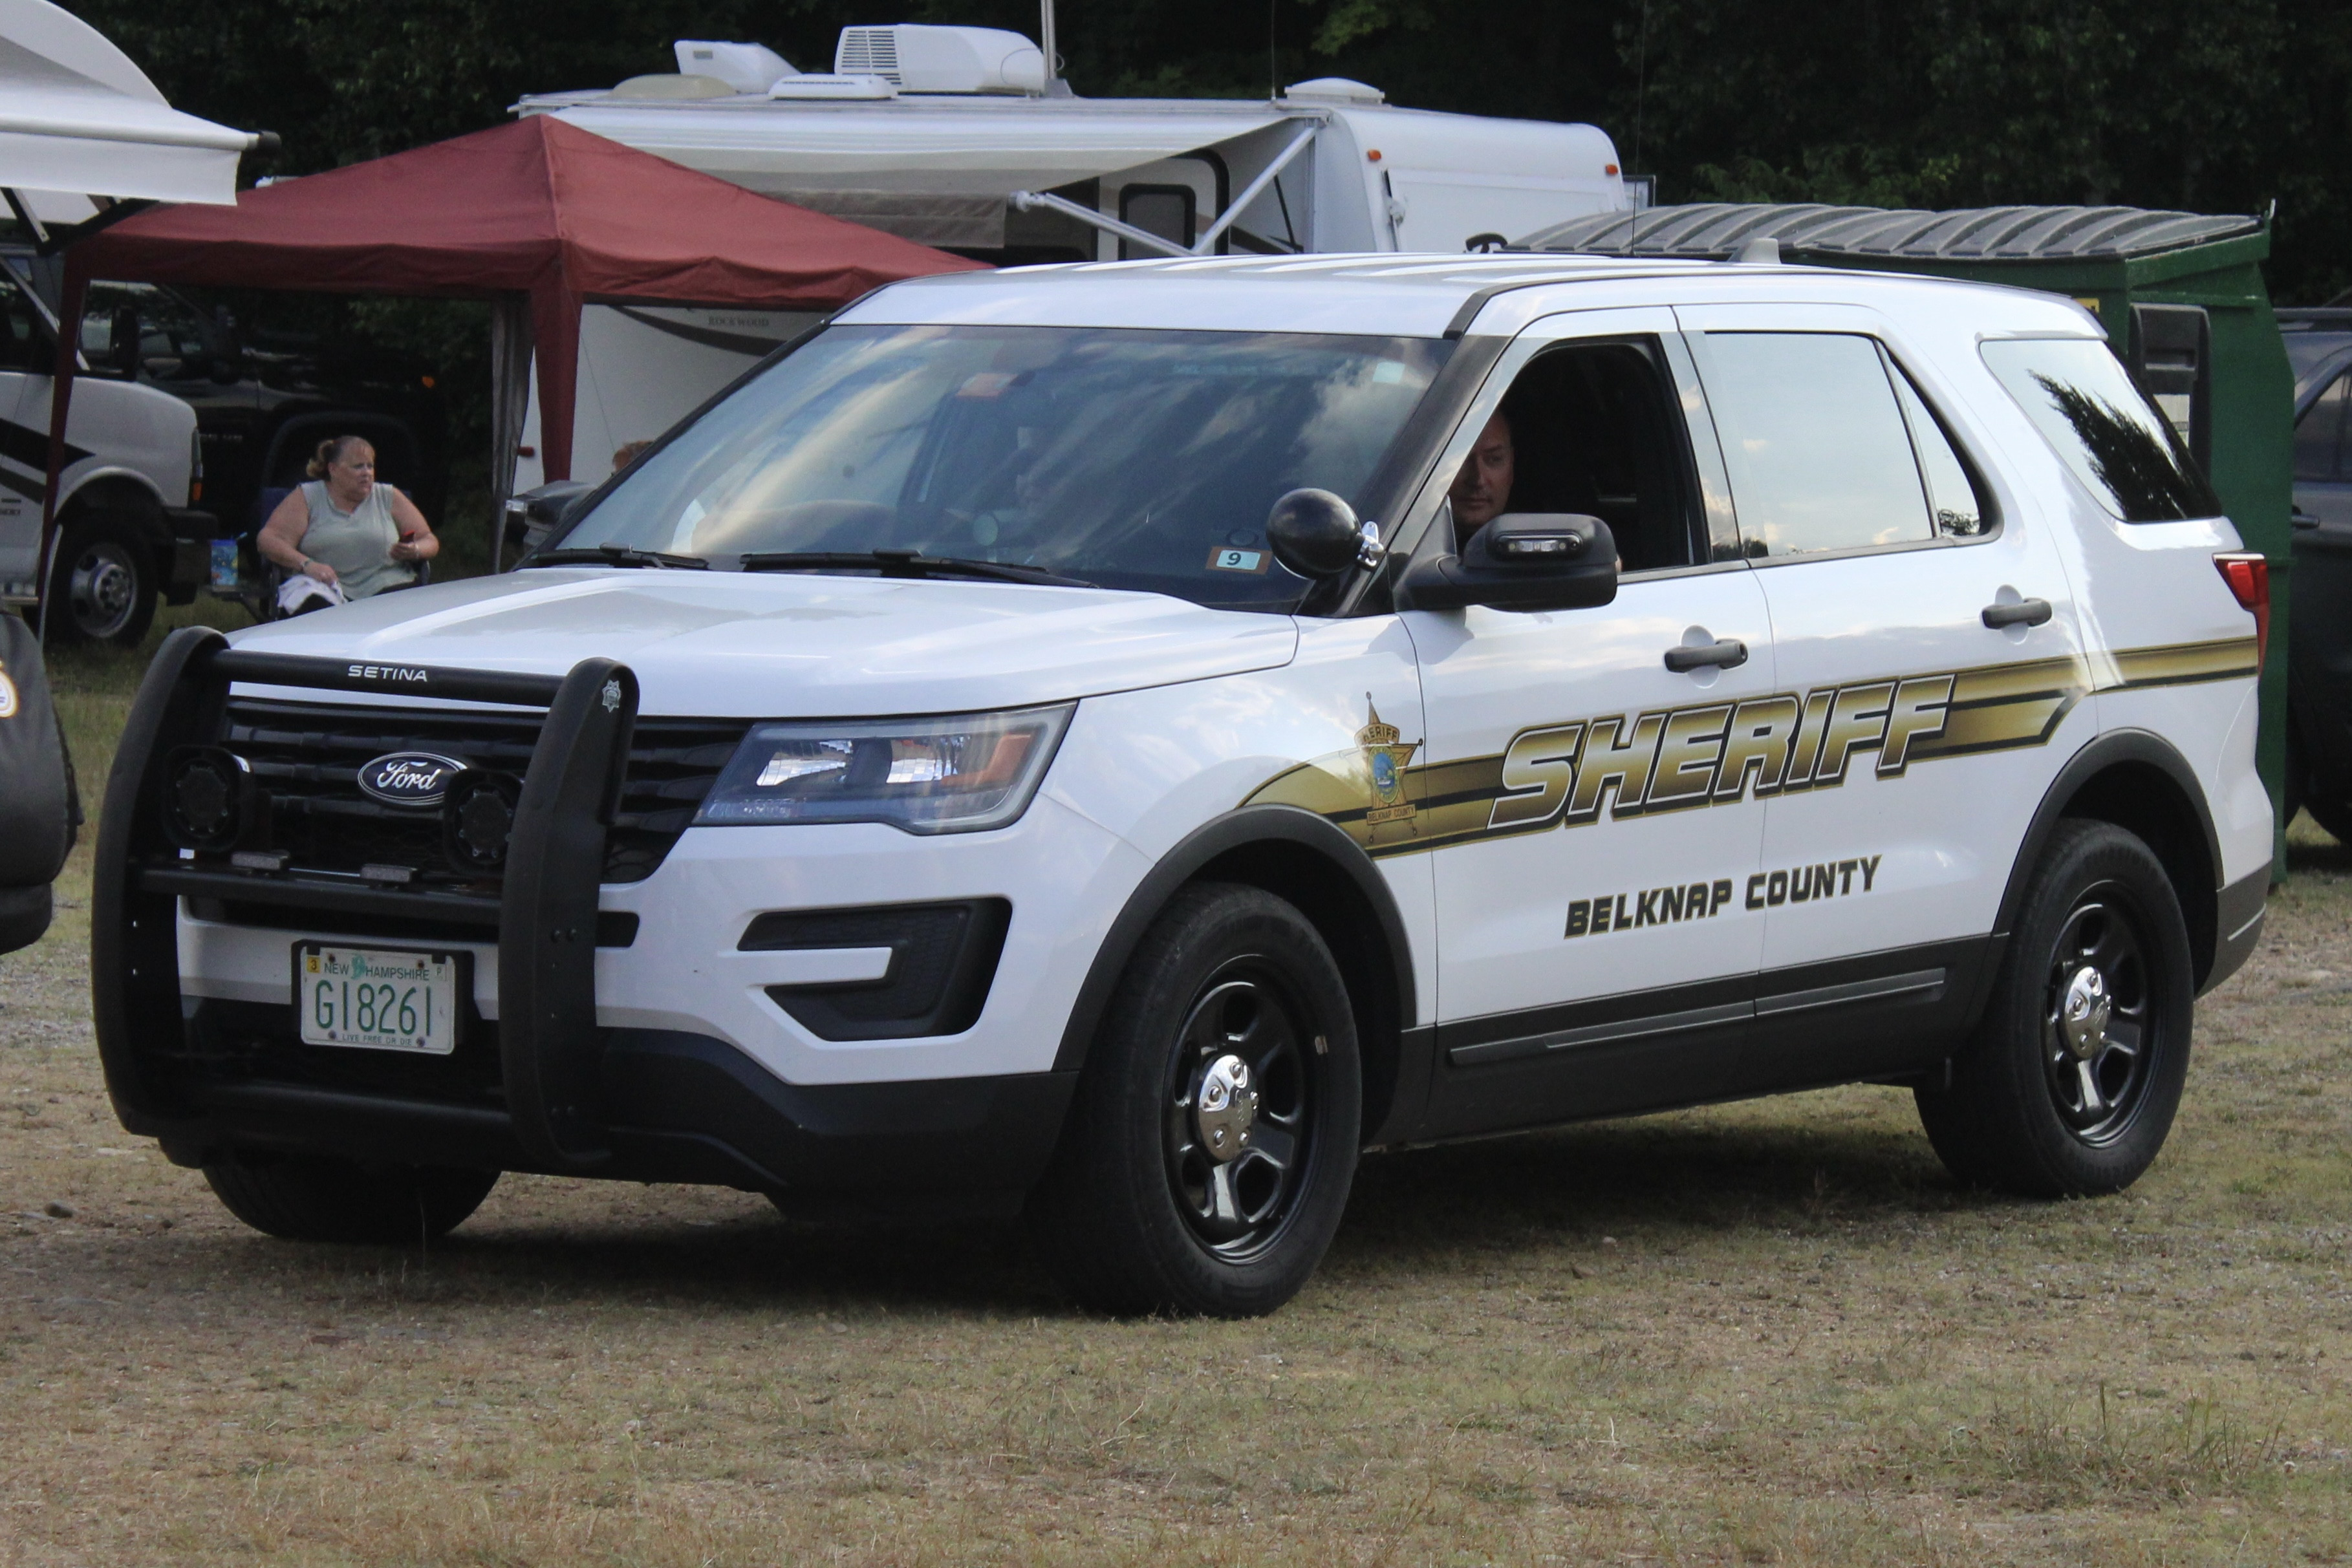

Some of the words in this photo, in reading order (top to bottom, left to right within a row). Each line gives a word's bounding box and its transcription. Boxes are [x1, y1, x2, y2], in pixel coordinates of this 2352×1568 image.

[1226, 552, 1242, 566] 9
[347, 665, 427, 682] SETINA
[1486, 672, 1957, 832] SHERIFF
[376, 760, 442, 790] Ford
[1563, 878, 1732, 940] BELKNAP
[1745, 854, 1883, 912] COUNTY
[310, 959, 318, 971] 3
[323, 963, 349, 975] NEW
[365, 965, 429, 981] HAMPSHIRE
[315, 980, 431, 1036] G18261
[342, 1033, 360, 1042] LIVE
[363, 1035, 382, 1044] FREE
